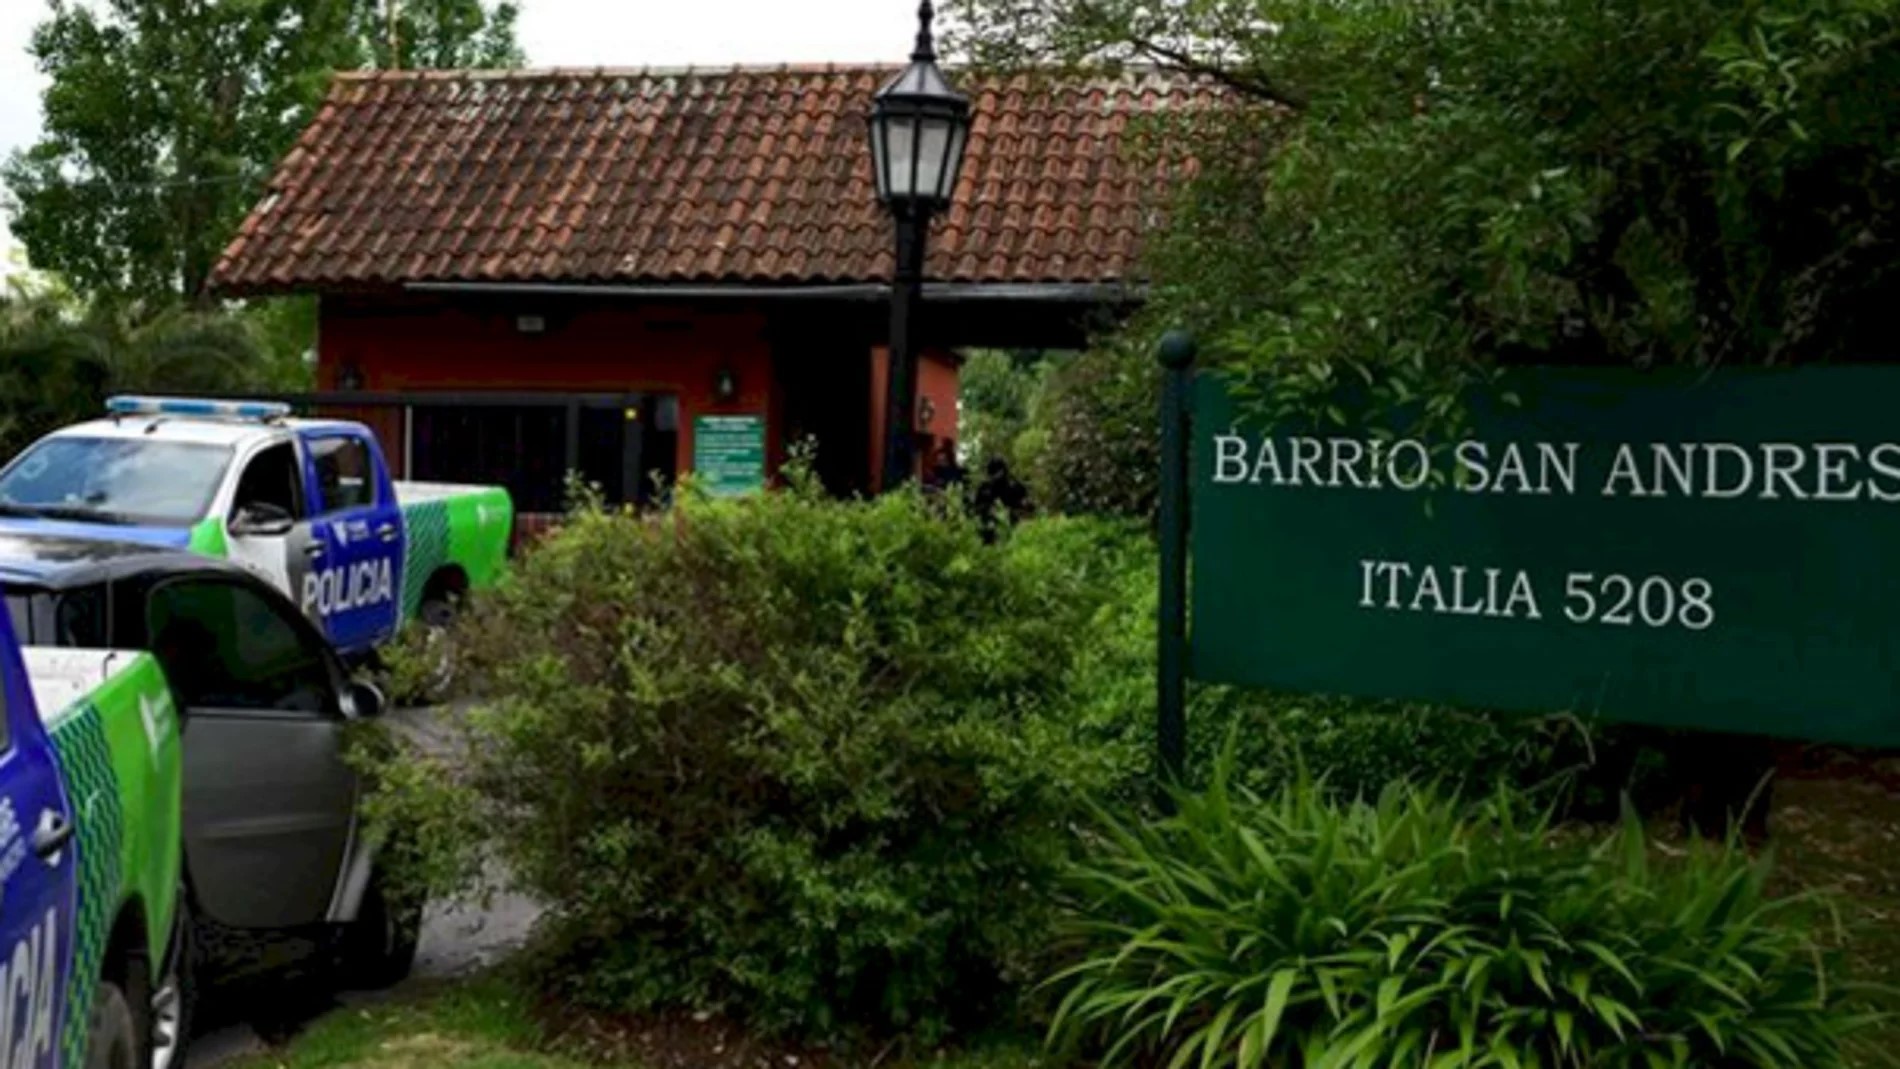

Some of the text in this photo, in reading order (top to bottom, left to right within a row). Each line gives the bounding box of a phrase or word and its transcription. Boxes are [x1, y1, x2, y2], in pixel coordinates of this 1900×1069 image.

[1212, 434, 1900, 501] BARRIO SAN ANDRES
[302, 557, 393, 615] POLICIA
[1360, 560, 1714, 629] ITALIA 5208
